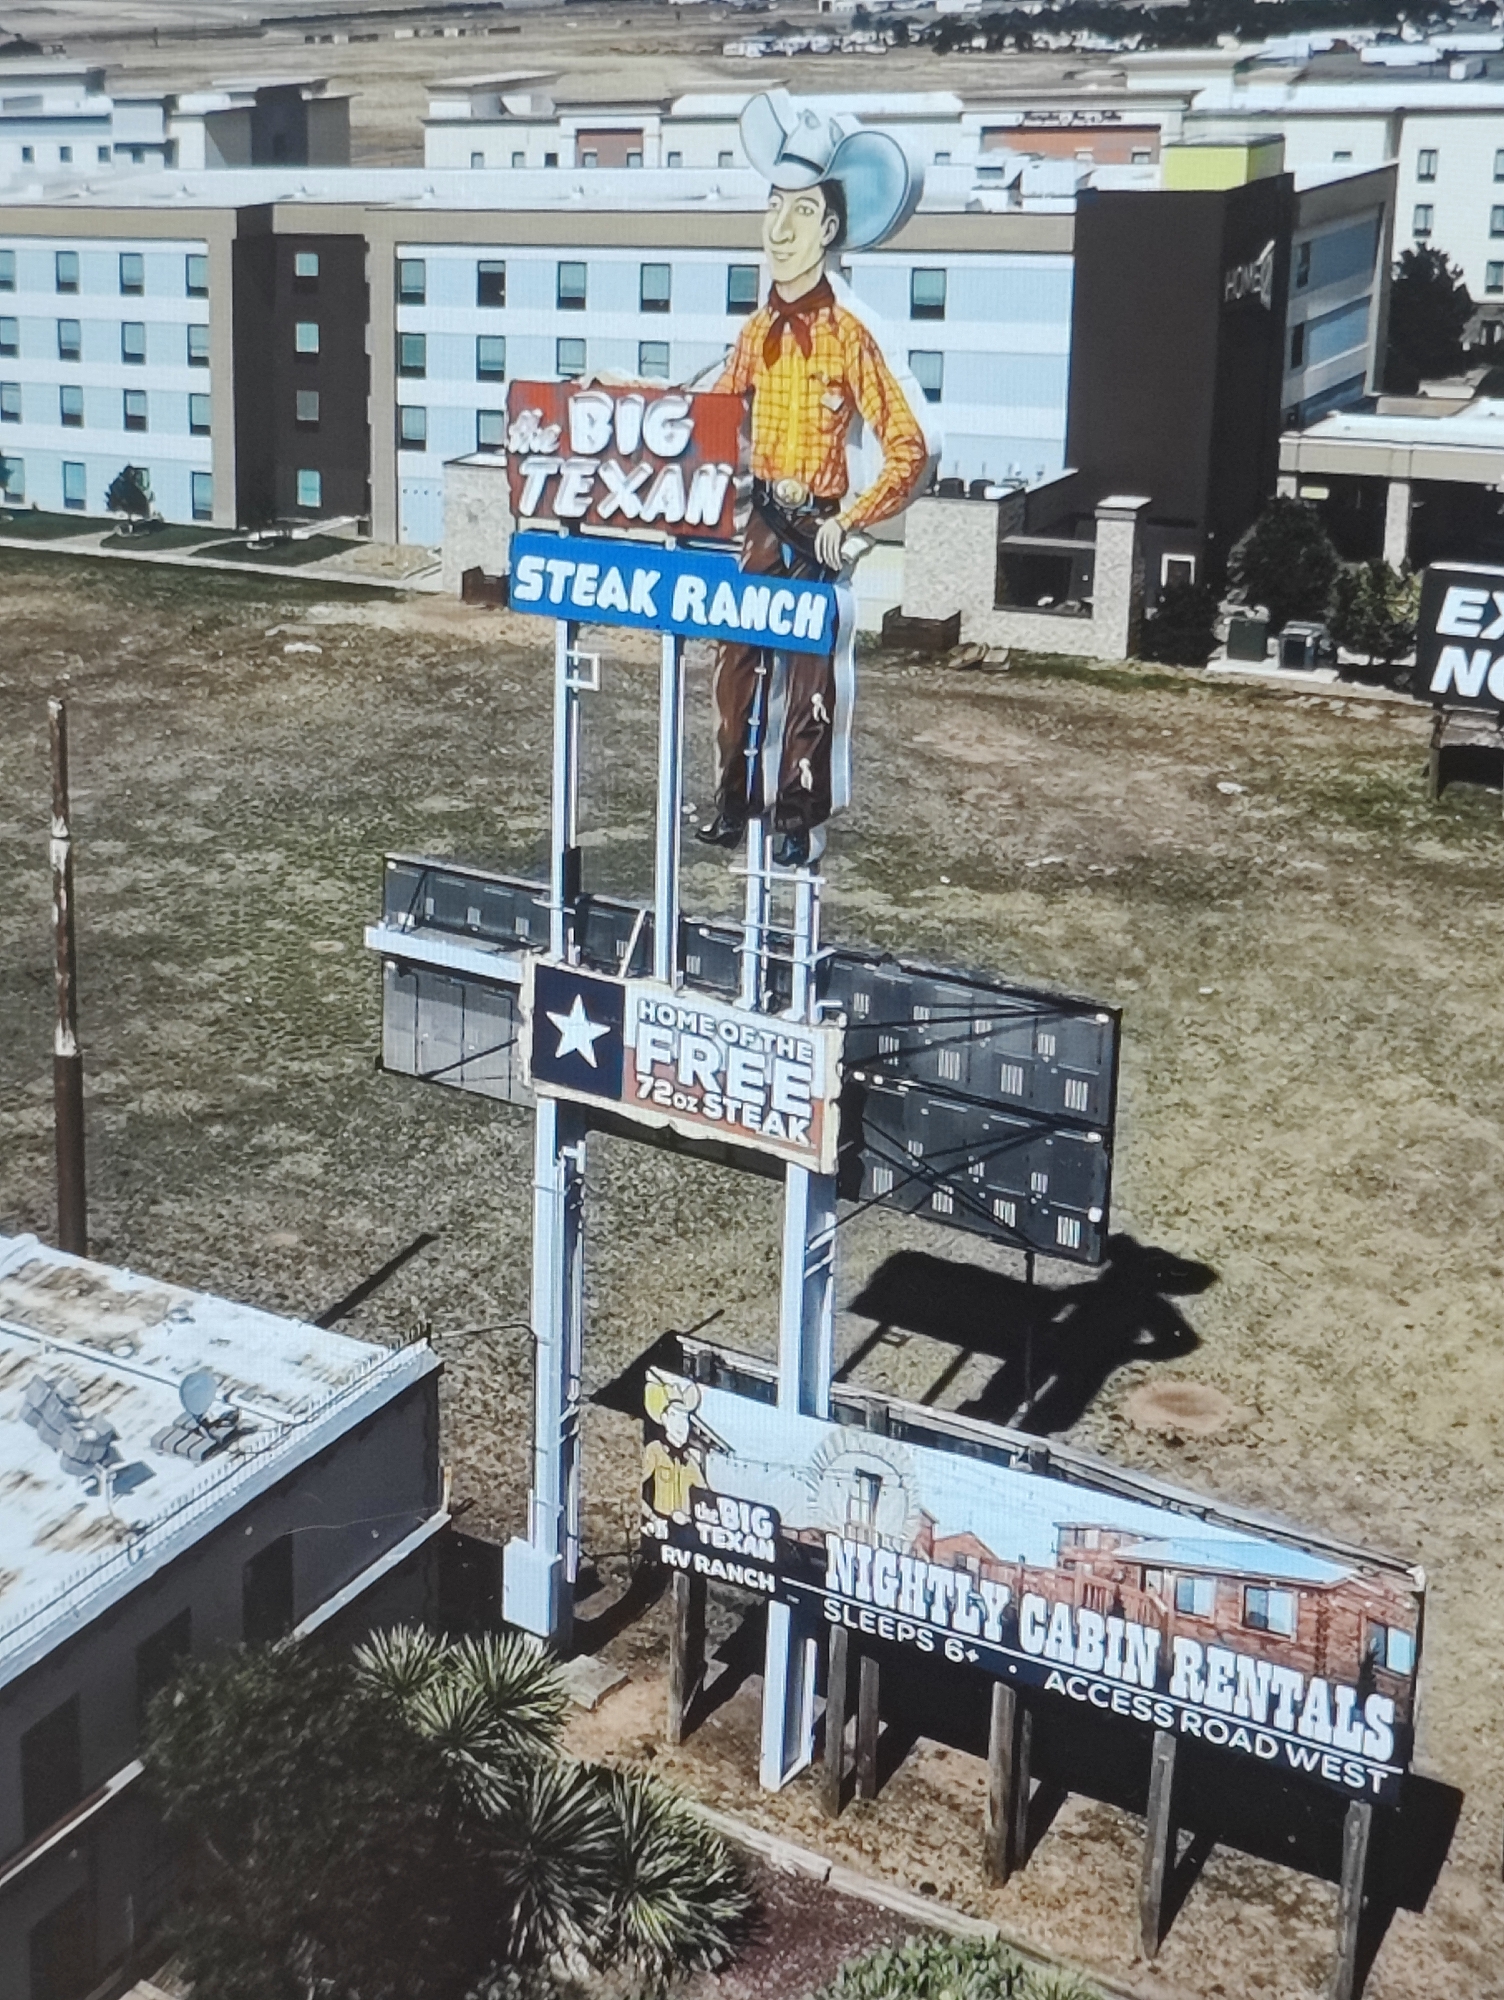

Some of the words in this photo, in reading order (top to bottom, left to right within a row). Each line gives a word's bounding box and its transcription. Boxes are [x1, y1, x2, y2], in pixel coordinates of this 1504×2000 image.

[507, 408, 562, 454] the
[568, 391, 695, 457] BIG
[518, 456, 735, 526] TEXAN
[513, 555, 661, 618] STEAK
[671, 574, 828, 641] RANCH
[639, 999, 717, 1038] HOME
[718, 1019, 759, 1047] OF
[758, 1029, 814, 1065] THE
[636, 1022, 813, 1119] FREE
[702, 1093, 812, 1147] STEAK
[695, 1521, 776, 1563] TEXAN
[716, 1496, 775, 1540] BIG
[660, 1543, 693, 1569] RV
[693, 1552, 776, 1594] RANCH
[824, 1532, 1012, 1643] NIGHTLY
[1019, 1592, 1162, 1689] CABIN
[1169, 1635, 1395, 1763] RENTALS
[823, 1598, 936, 1653] SLEEPS
[943, 1638, 981, 1664] 6+
[1044, 1670, 1175, 1729] ACCESS
[1180, 1710, 1279, 1761] ROAD
[1285, 1741, 1390, 1795] WEST
